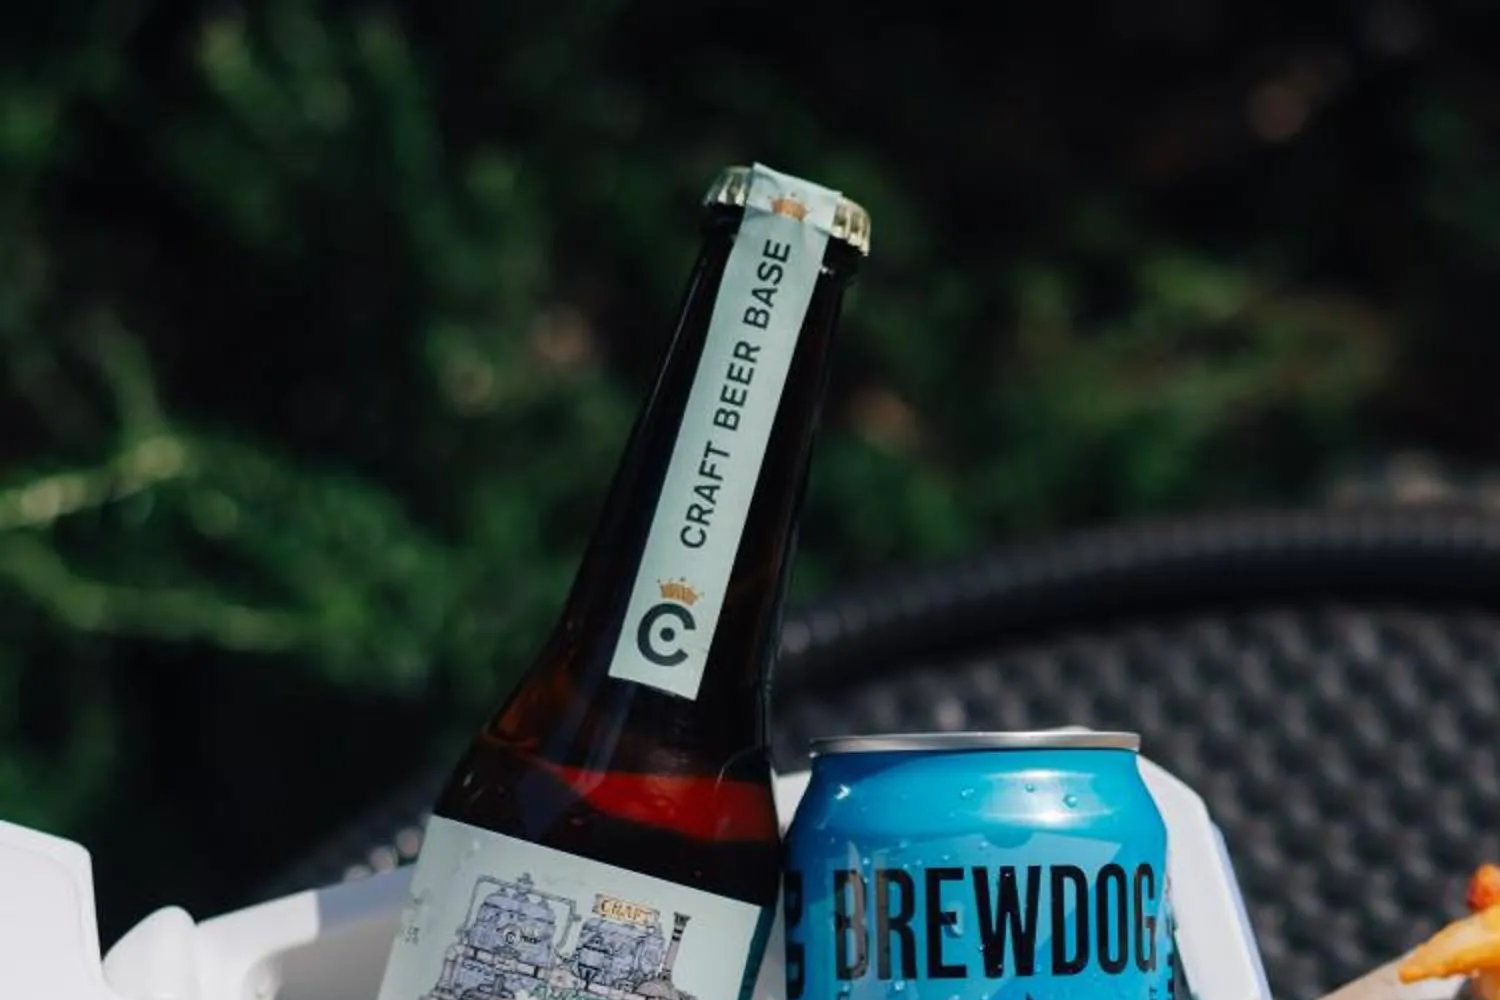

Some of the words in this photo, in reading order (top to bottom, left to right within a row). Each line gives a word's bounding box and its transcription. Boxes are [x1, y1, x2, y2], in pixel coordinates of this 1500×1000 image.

[680, 441, 731, 549] CRAFT
[713, 340, 762, 431] BEER
[742, 239, 791, 329] BASE
[833, 863, 1156, 981] BREWDOG
